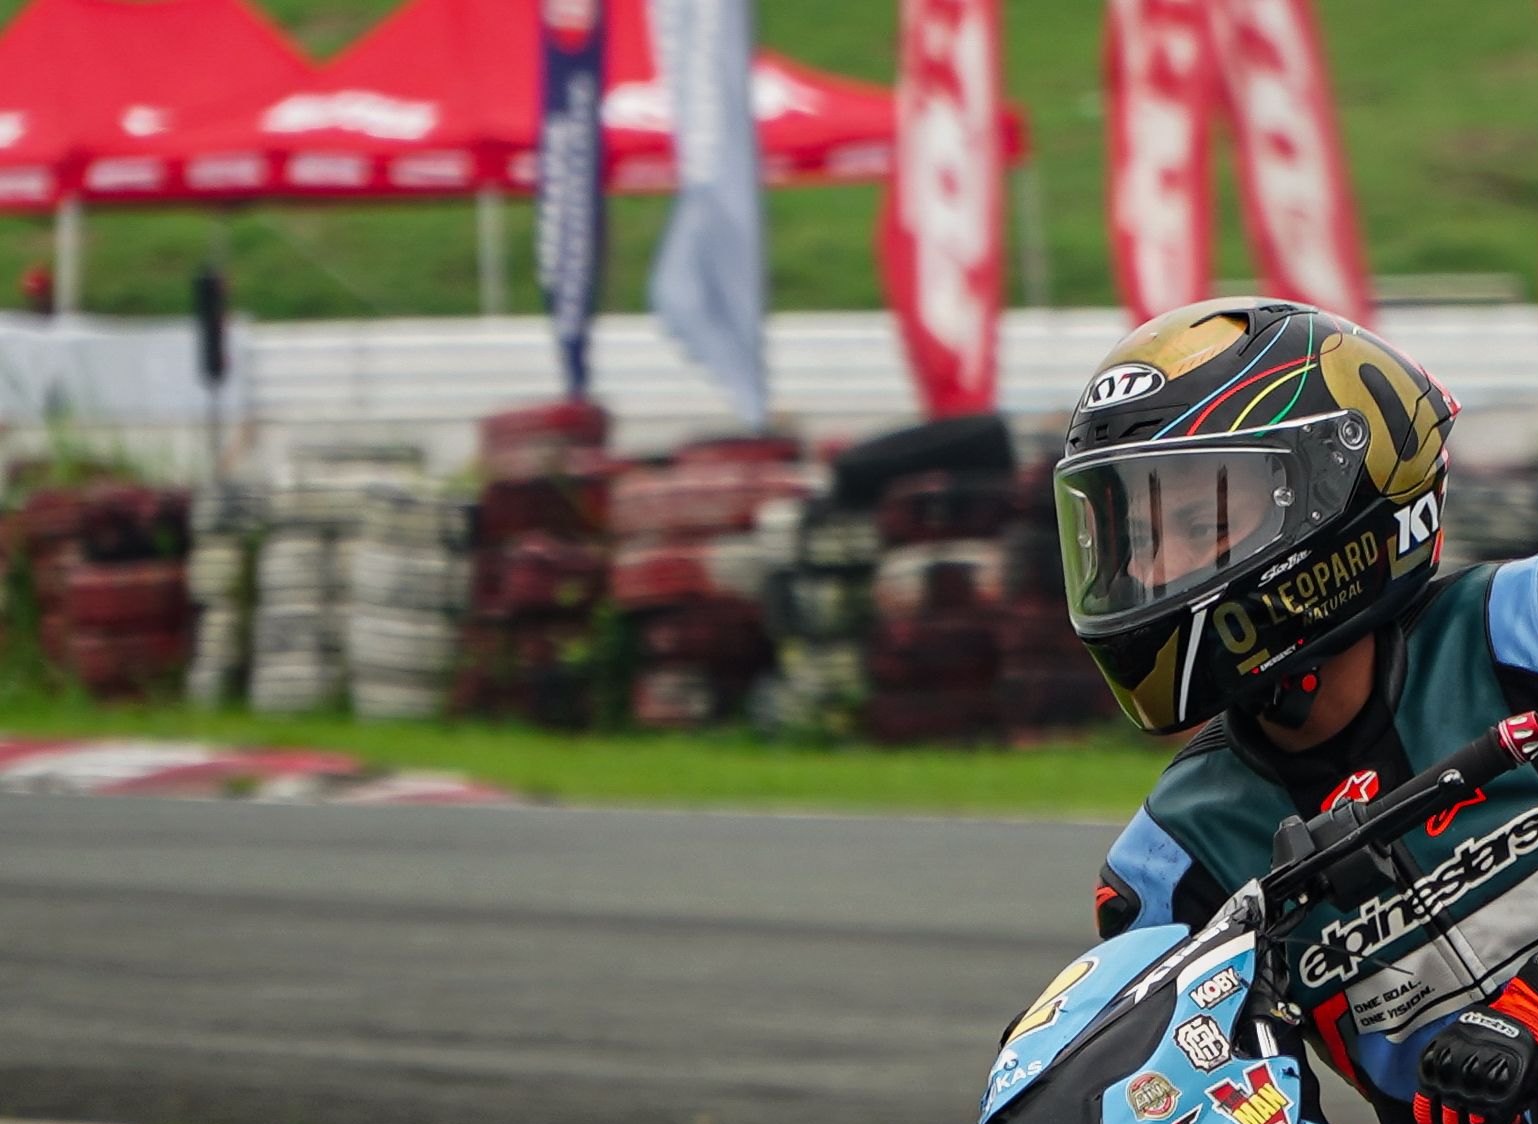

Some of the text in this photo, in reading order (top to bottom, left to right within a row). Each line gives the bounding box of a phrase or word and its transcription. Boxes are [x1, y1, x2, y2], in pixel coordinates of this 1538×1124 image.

[1393, 490, 1439, 555] KY
[1261, 530, 1378, 625] LEOPARD
[1191, 968, 1239, 1008] KOBY
[1354, 994, 1381, 1014] ONE
[1359, 1009, 1386, 1027] ONE
